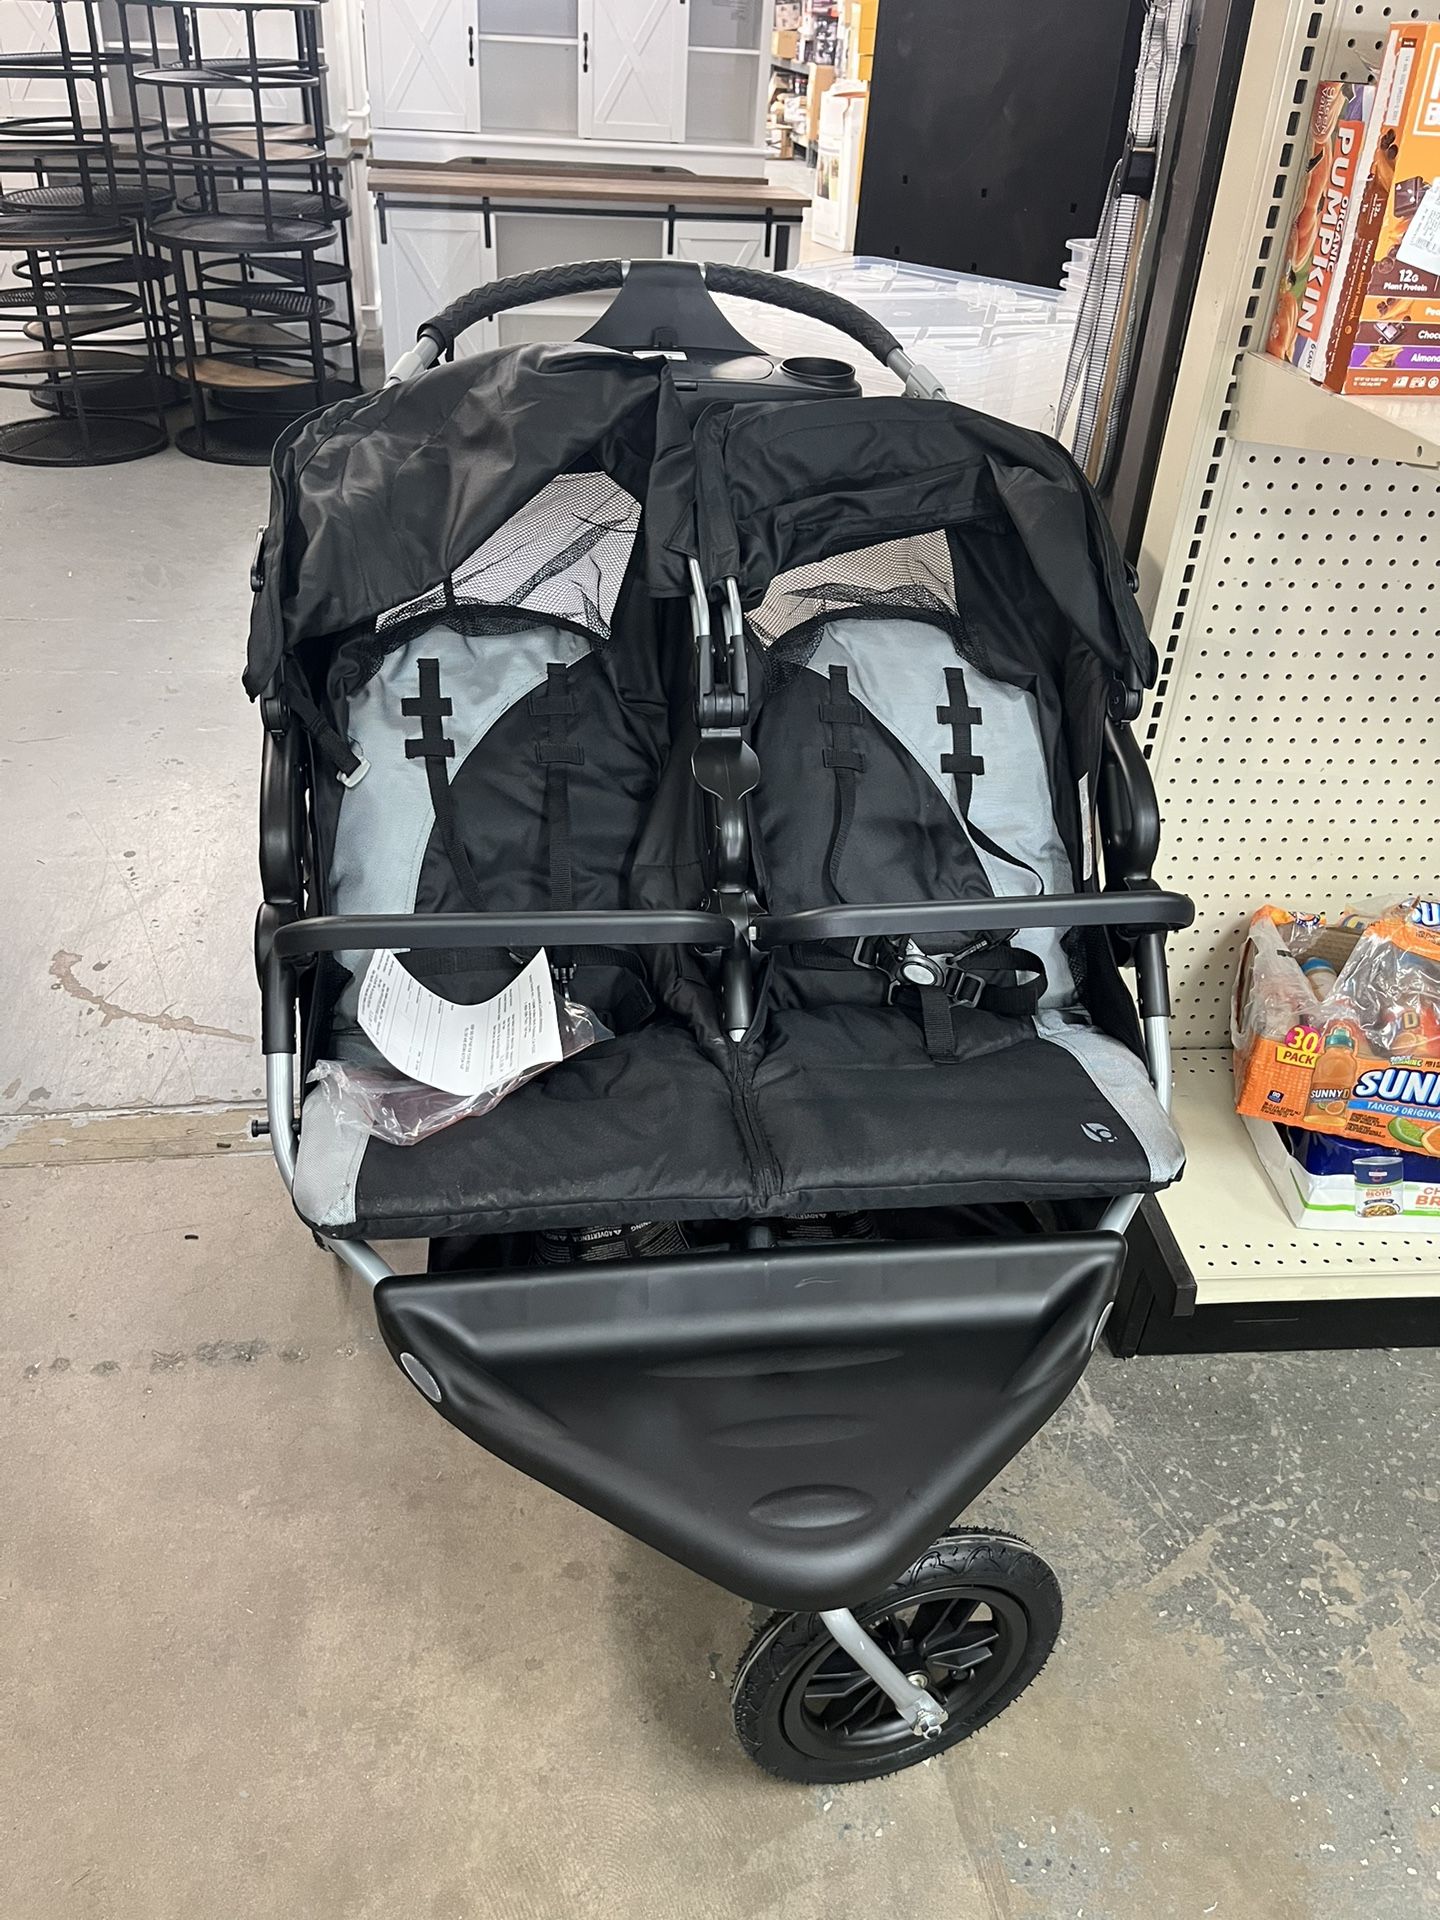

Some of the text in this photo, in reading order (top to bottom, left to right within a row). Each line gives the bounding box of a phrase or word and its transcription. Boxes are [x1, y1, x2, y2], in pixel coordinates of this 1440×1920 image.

[1297, 126, 1355, 333] PUMPKIN
[1326, 196, 1349, 274] ORGANIC
[1383, 282, 1428, 292] Plant Protein
[1305, 350, 1314, 369] CANS
[1287, 1026, 1320, 1054] 30
[1282, 1050, 1316, 1066] PACK
[1310, 1089, 1349, 1099] SUNNYD
[1367, 1101, 1399, 1113] TANGY
